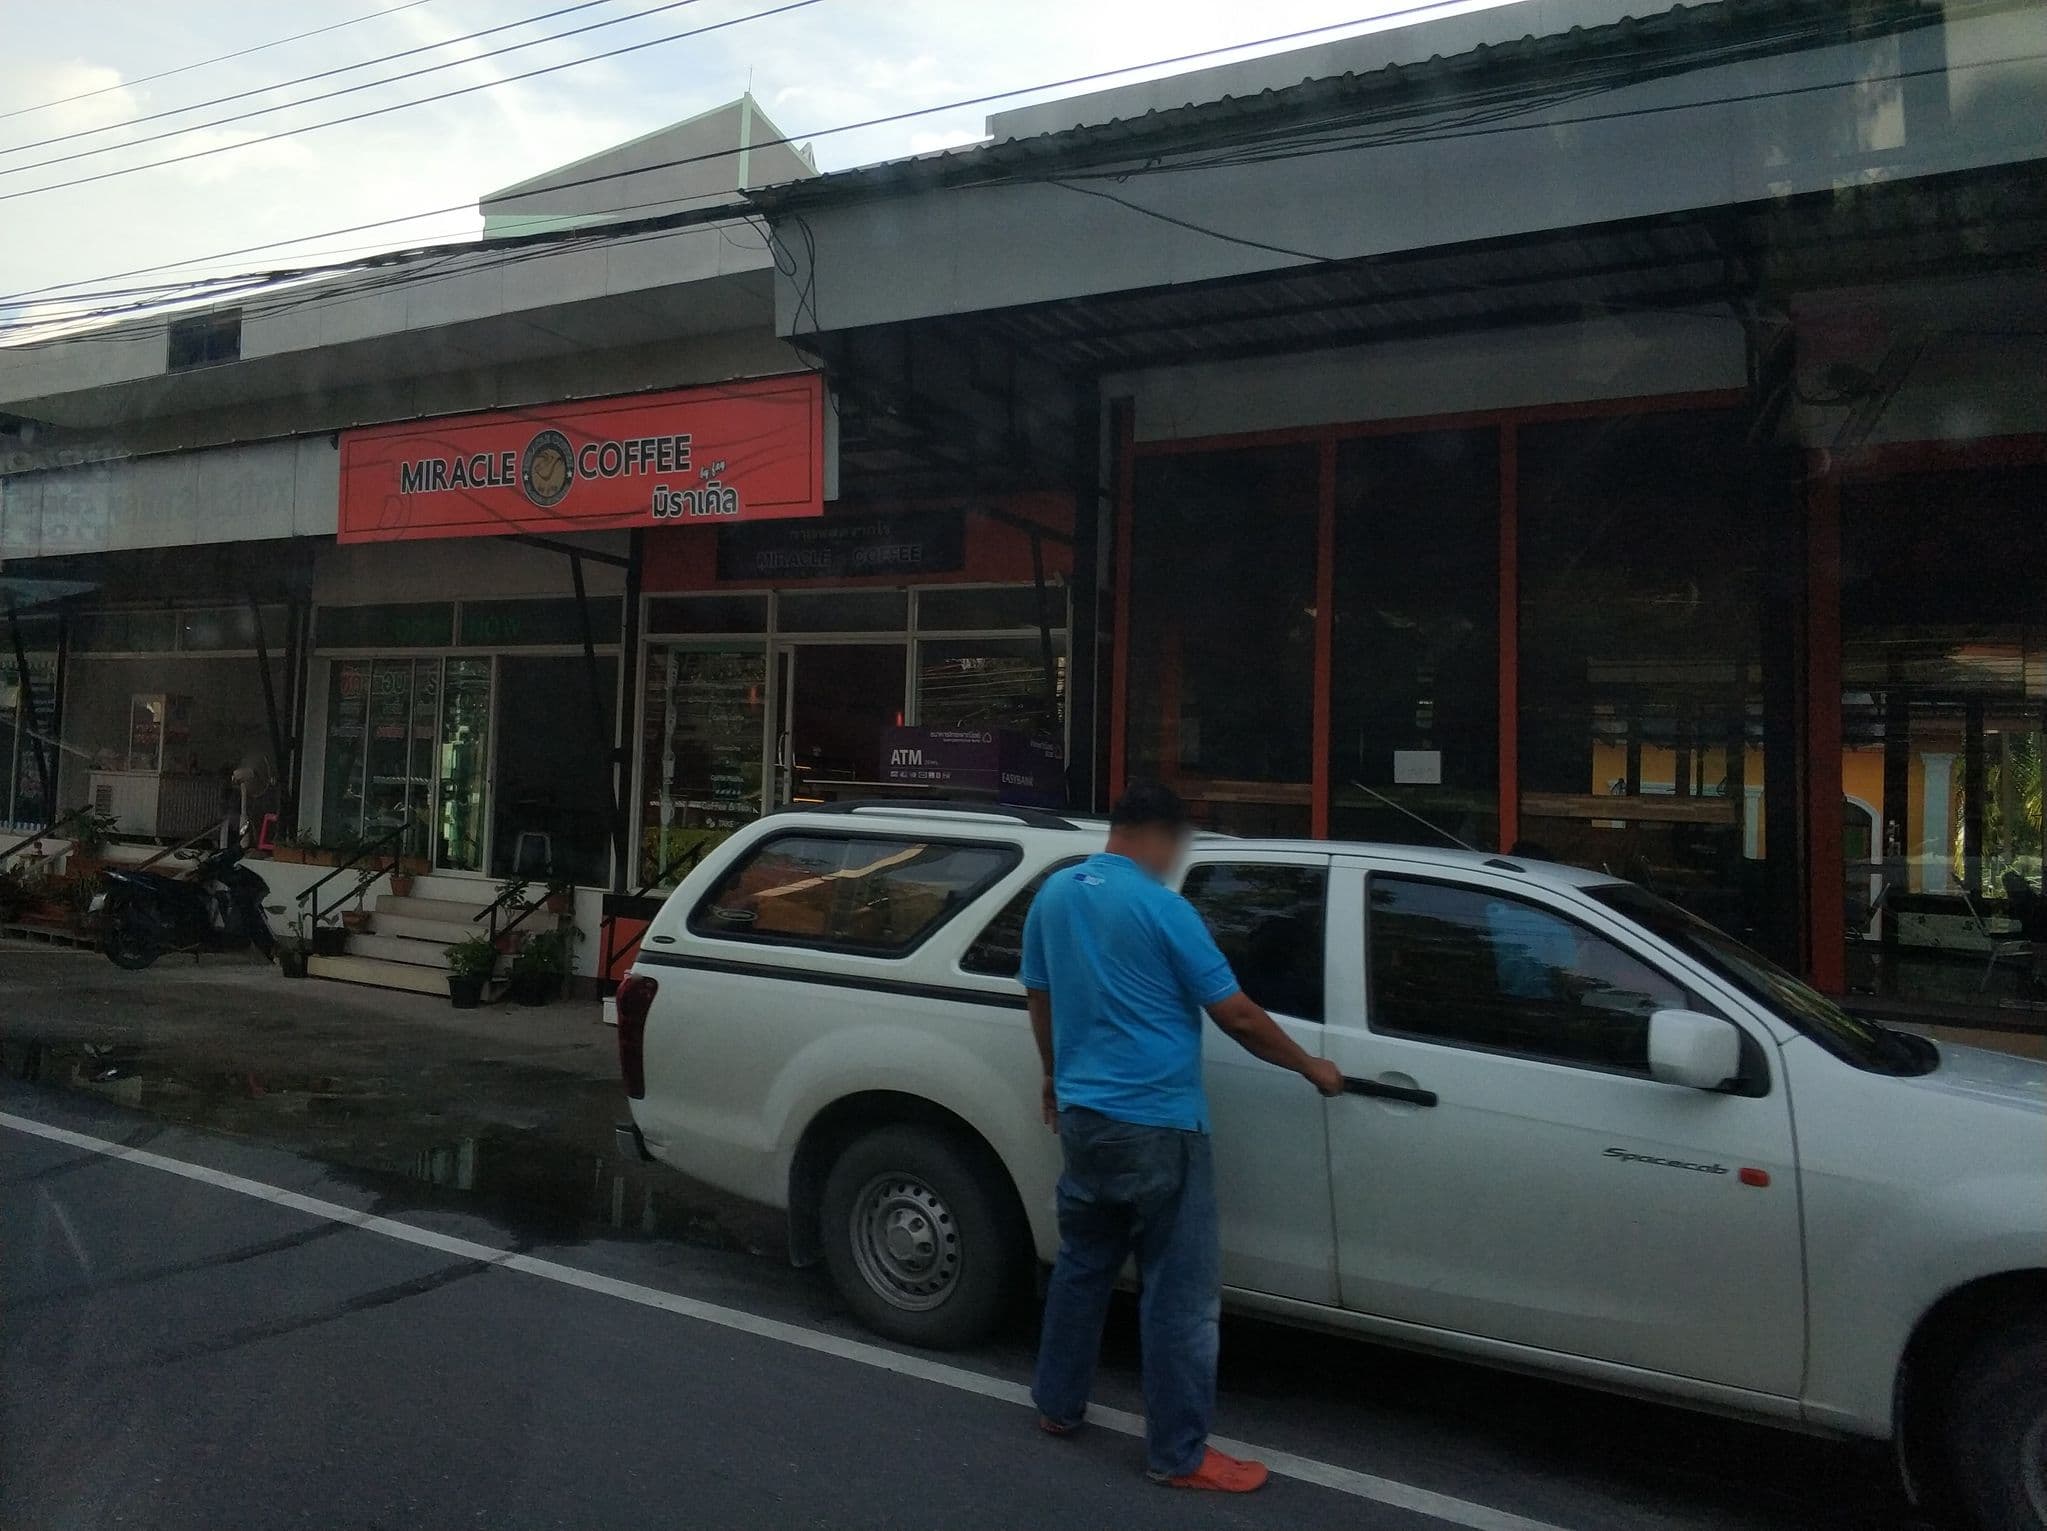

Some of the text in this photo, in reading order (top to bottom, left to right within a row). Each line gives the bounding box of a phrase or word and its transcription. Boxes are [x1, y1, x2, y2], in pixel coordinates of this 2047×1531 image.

[400, 451, 516, 495] MIRACLE
[577, 433, 693, 481] COFFEE
[653, 481, 738, 519] มิราเคิล
[890, 749, 923, 765] ATM
